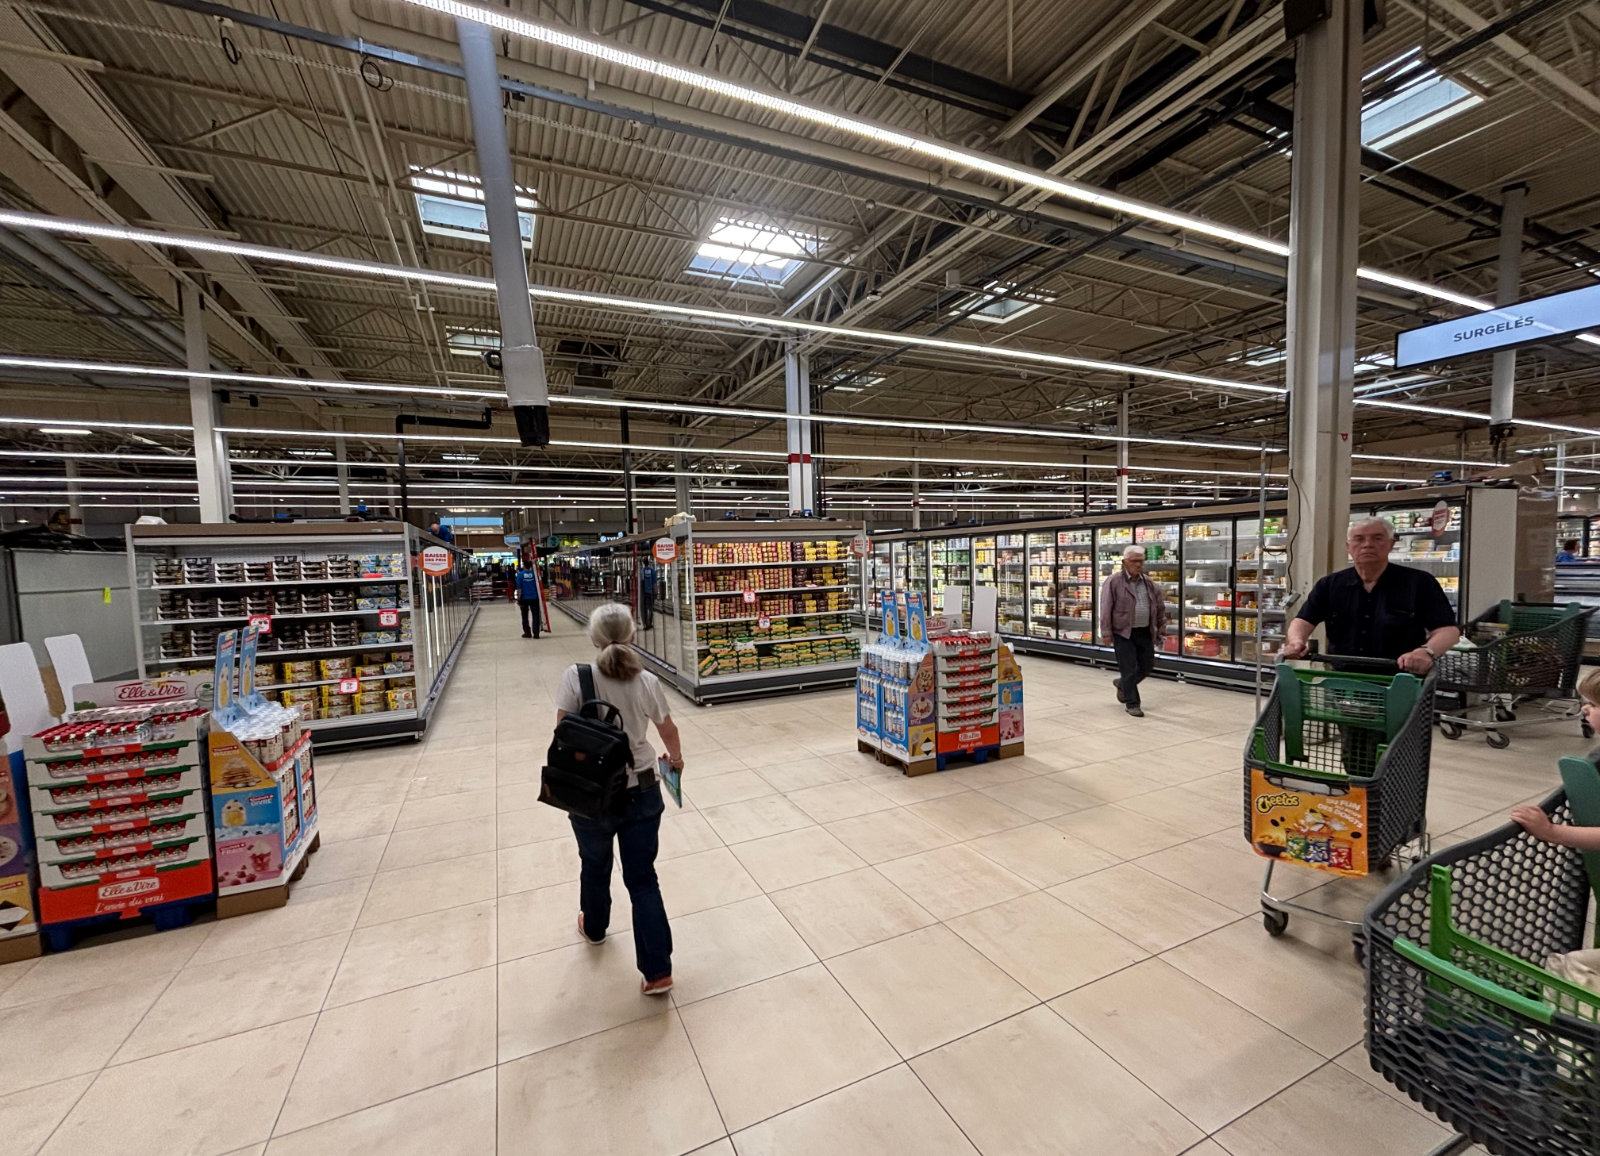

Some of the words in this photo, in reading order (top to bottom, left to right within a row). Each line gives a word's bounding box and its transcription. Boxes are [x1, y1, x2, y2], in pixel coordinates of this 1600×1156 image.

[1453, 316, 1534, 342] SURGELÉS
[118, 686, 145, 699] Elle
[158, 682, 186, 696] Vire
[1257, 793, 1299, 813] Cheetos
[134, 880, 156, 891] Vire
[128, 896, 143, 907] du
